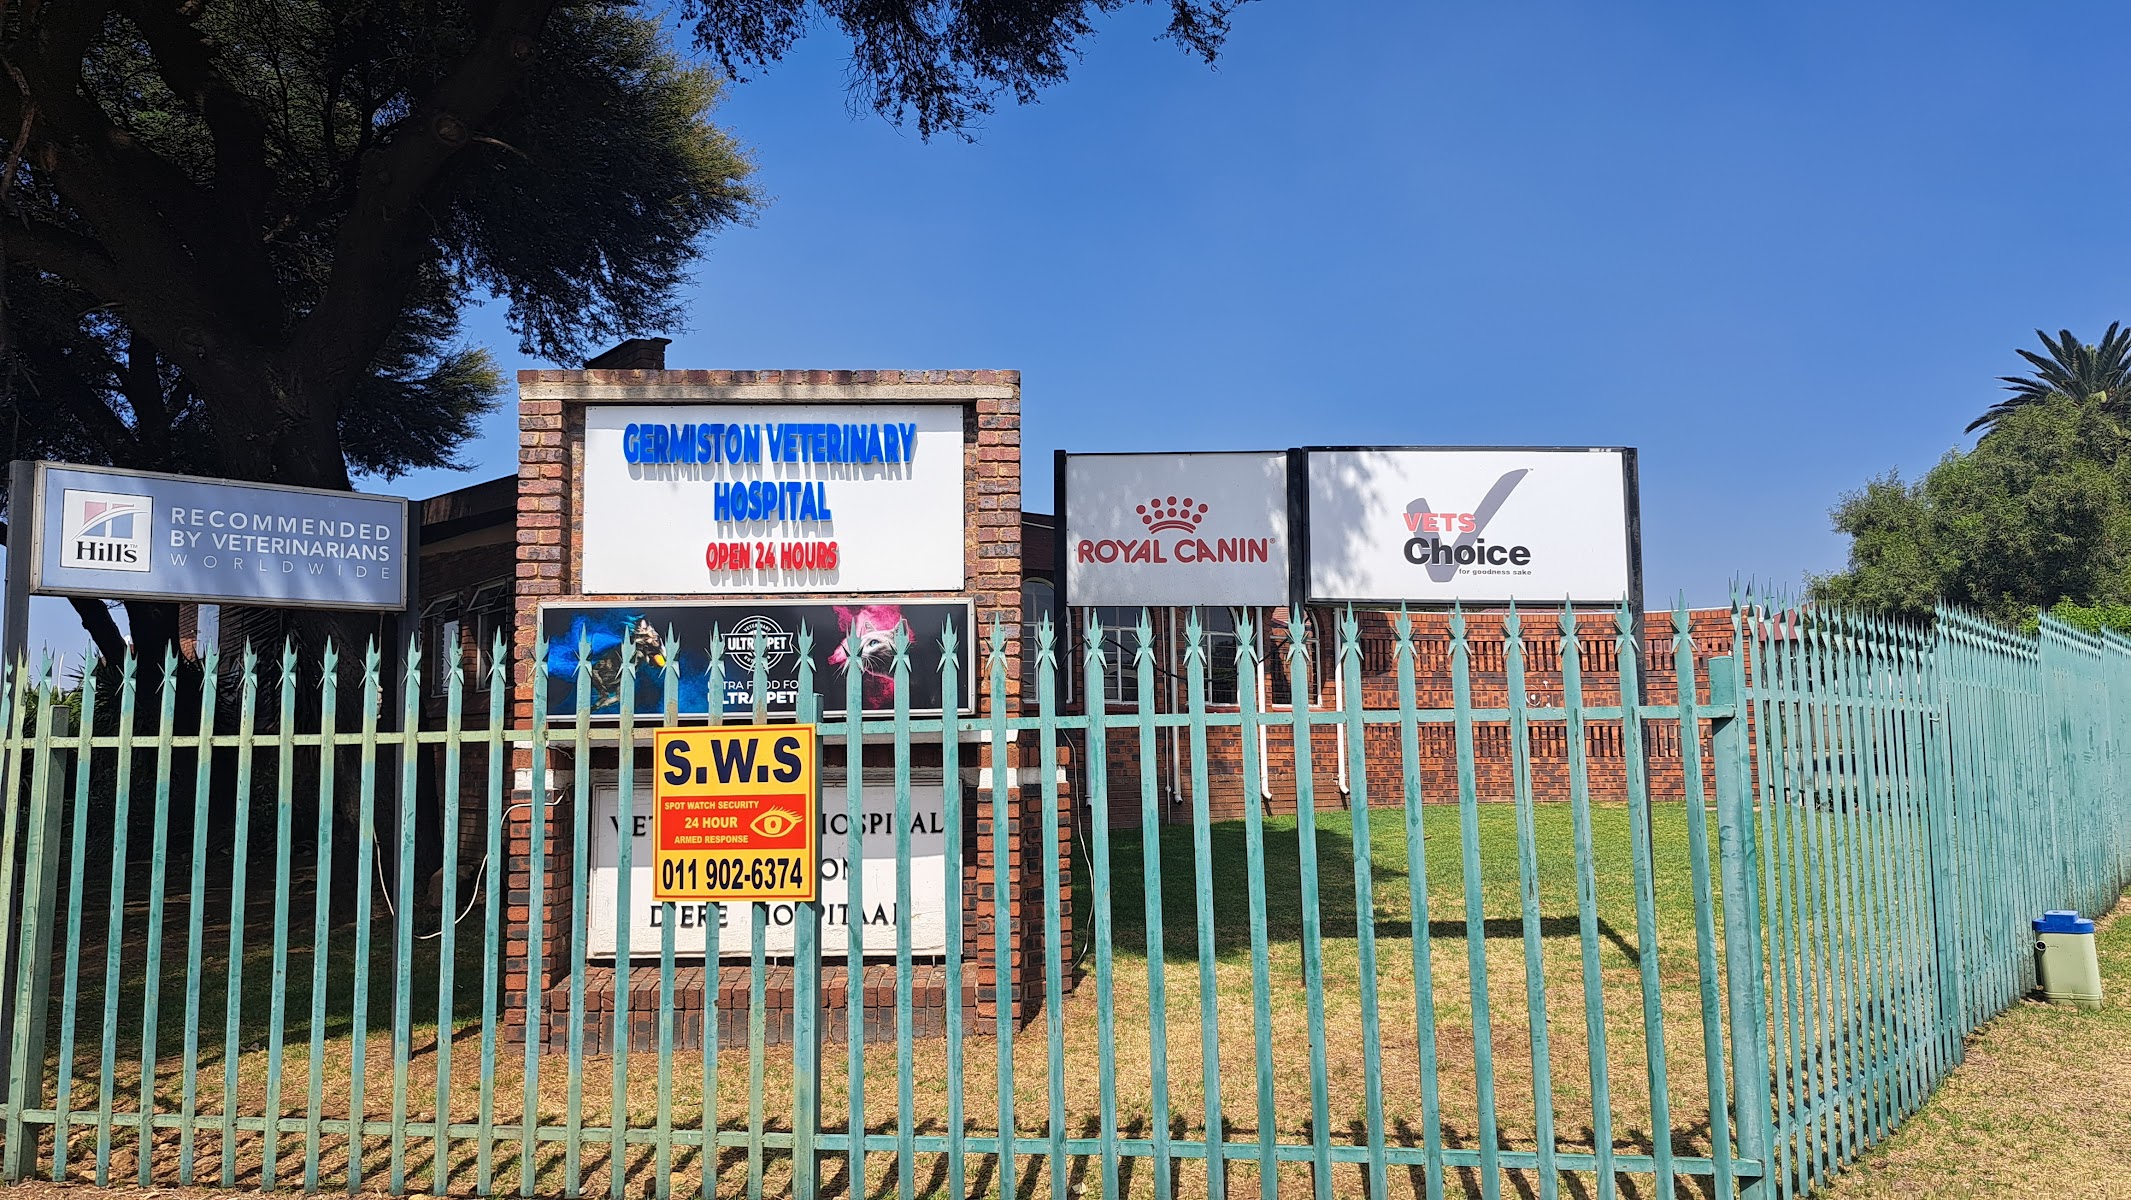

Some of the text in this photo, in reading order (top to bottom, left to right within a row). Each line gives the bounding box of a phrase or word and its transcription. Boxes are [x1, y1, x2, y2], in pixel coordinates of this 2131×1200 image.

[623, 423, 916, 464] GERMISTON VETERINARY
[714, 481, 832, 521] HOSPITAL
[171, 507, 391, 541] RECOMMENDED
[1403, 513, 1476, 532] VETS
[76, 541, 137, 563] Hill's
[170, 529, 390, 562] BY VETERINARIANS
[706, 542, 838, 570] OPEN 24 HOURS
[1078, 538, 1268, 563] ROYAL CANIN
[1404, 537, 1531, 566] Choice
[170, 553, 390, 579] WORLDWIDE
[1472, 568, 1511, 576] goodness
[1513, 568, 1532, 576] sake
[727, 637, 755, 651] ULTR
[747, 680, 780, 690] FOD
[784, 680, 800, 690] FO
[664, 736, 802, 786] S.W.S
[664, 801, 760, 810] SPOT WATCH SECURITY
[684, 816, 738, 829] 24 HOUR
[674, 835, 749, 844] ARMED RESPONSE
[663, 858, 697, 890] 011
[706, 857, 803, 890] 902-6374
